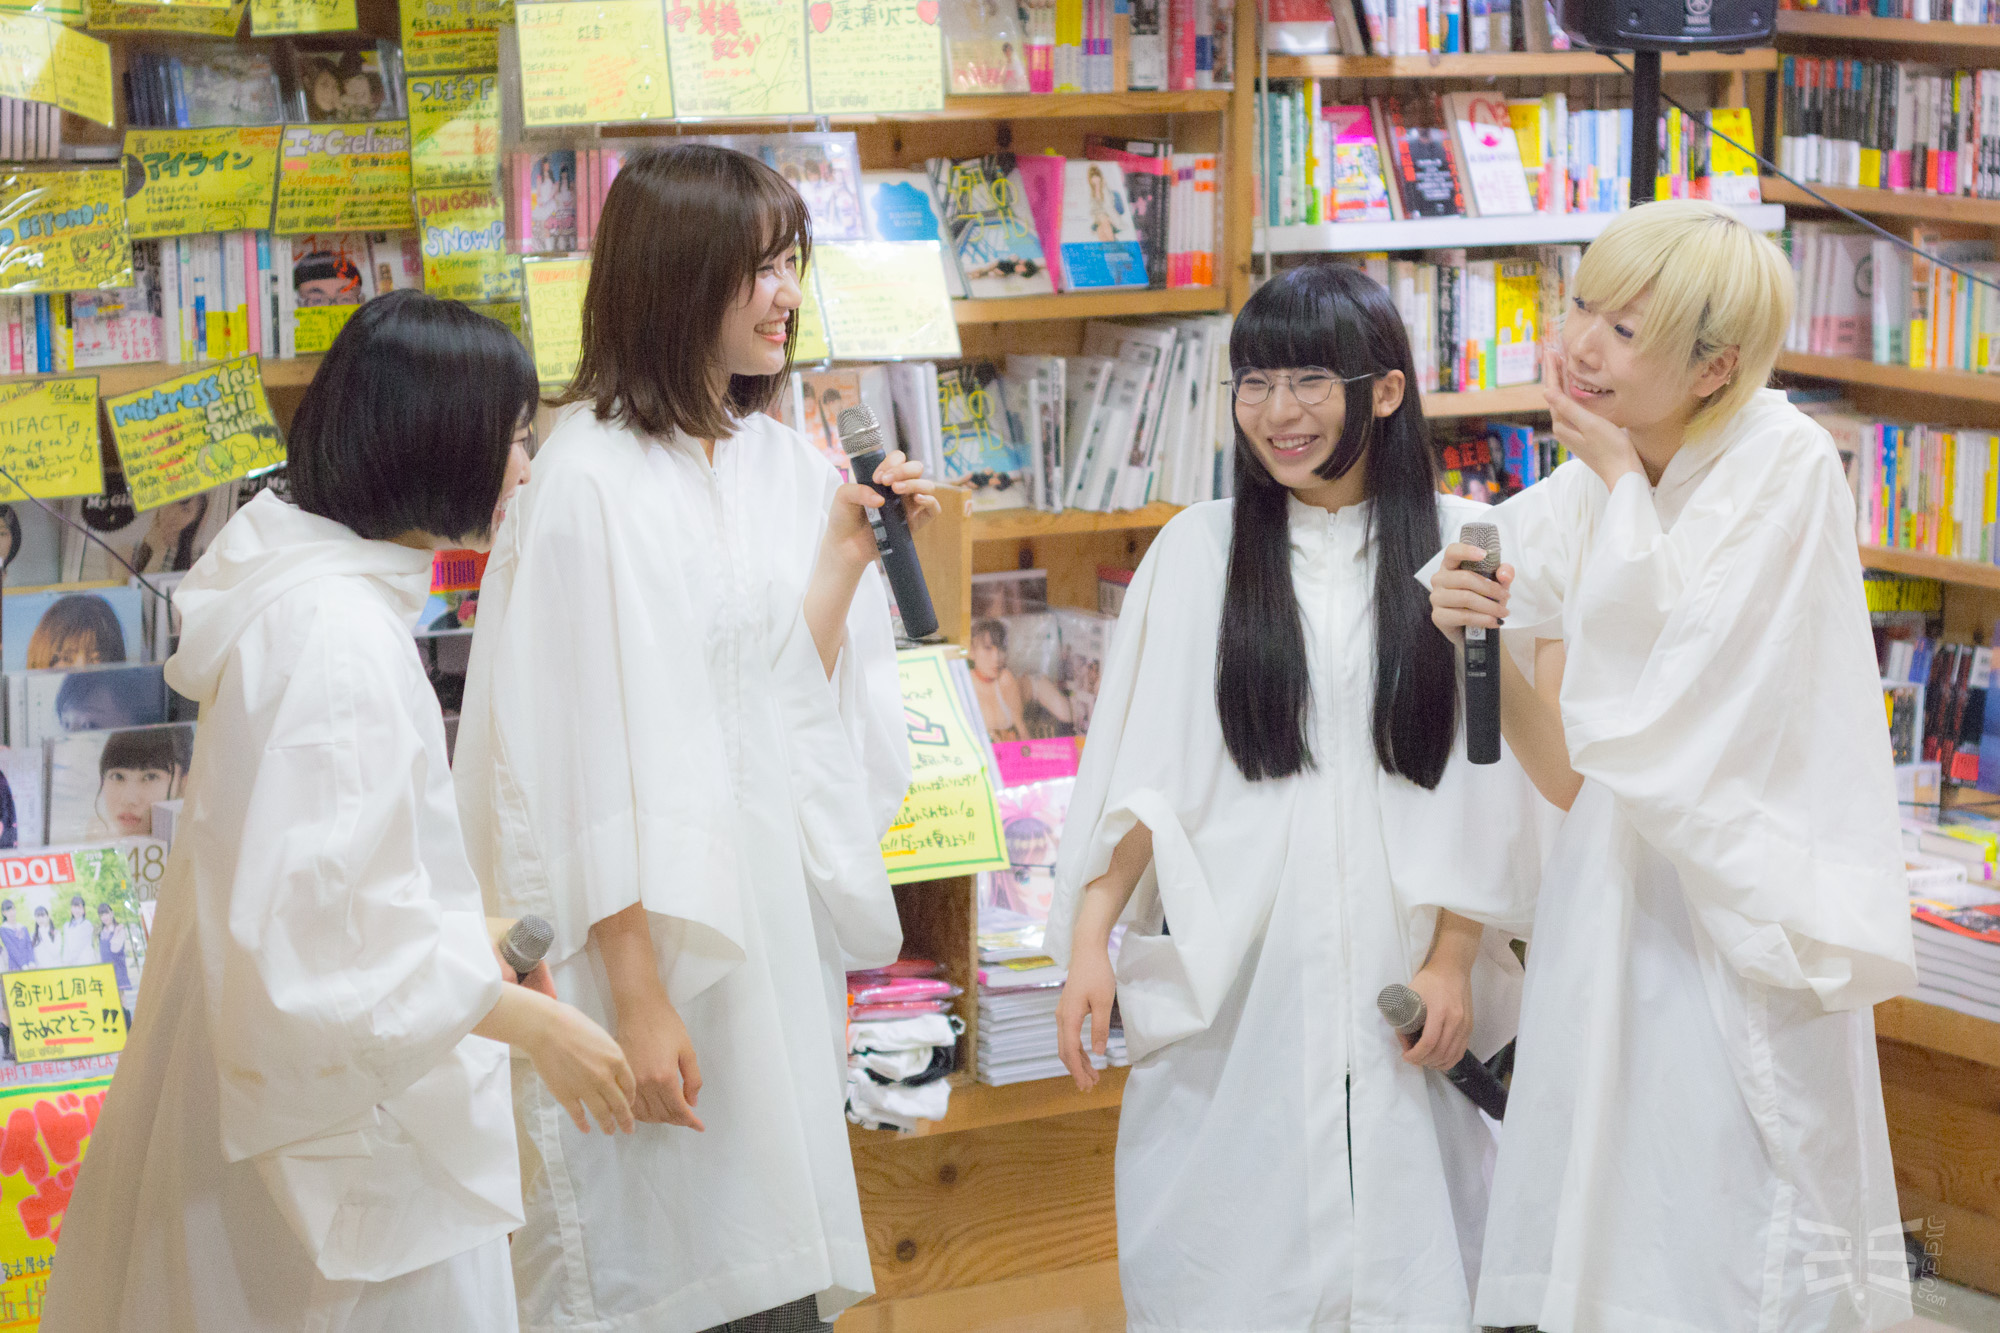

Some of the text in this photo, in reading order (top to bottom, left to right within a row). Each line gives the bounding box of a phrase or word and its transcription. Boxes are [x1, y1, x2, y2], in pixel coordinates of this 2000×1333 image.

[143, 150, 253, 181] アイライン
[9, 976, 104, 1009] 創刊1周年
[17, 1008, 119, 1041] おめでとう!!
[0, 1055, 113, 1083] 刊1周年に SAY-LA
